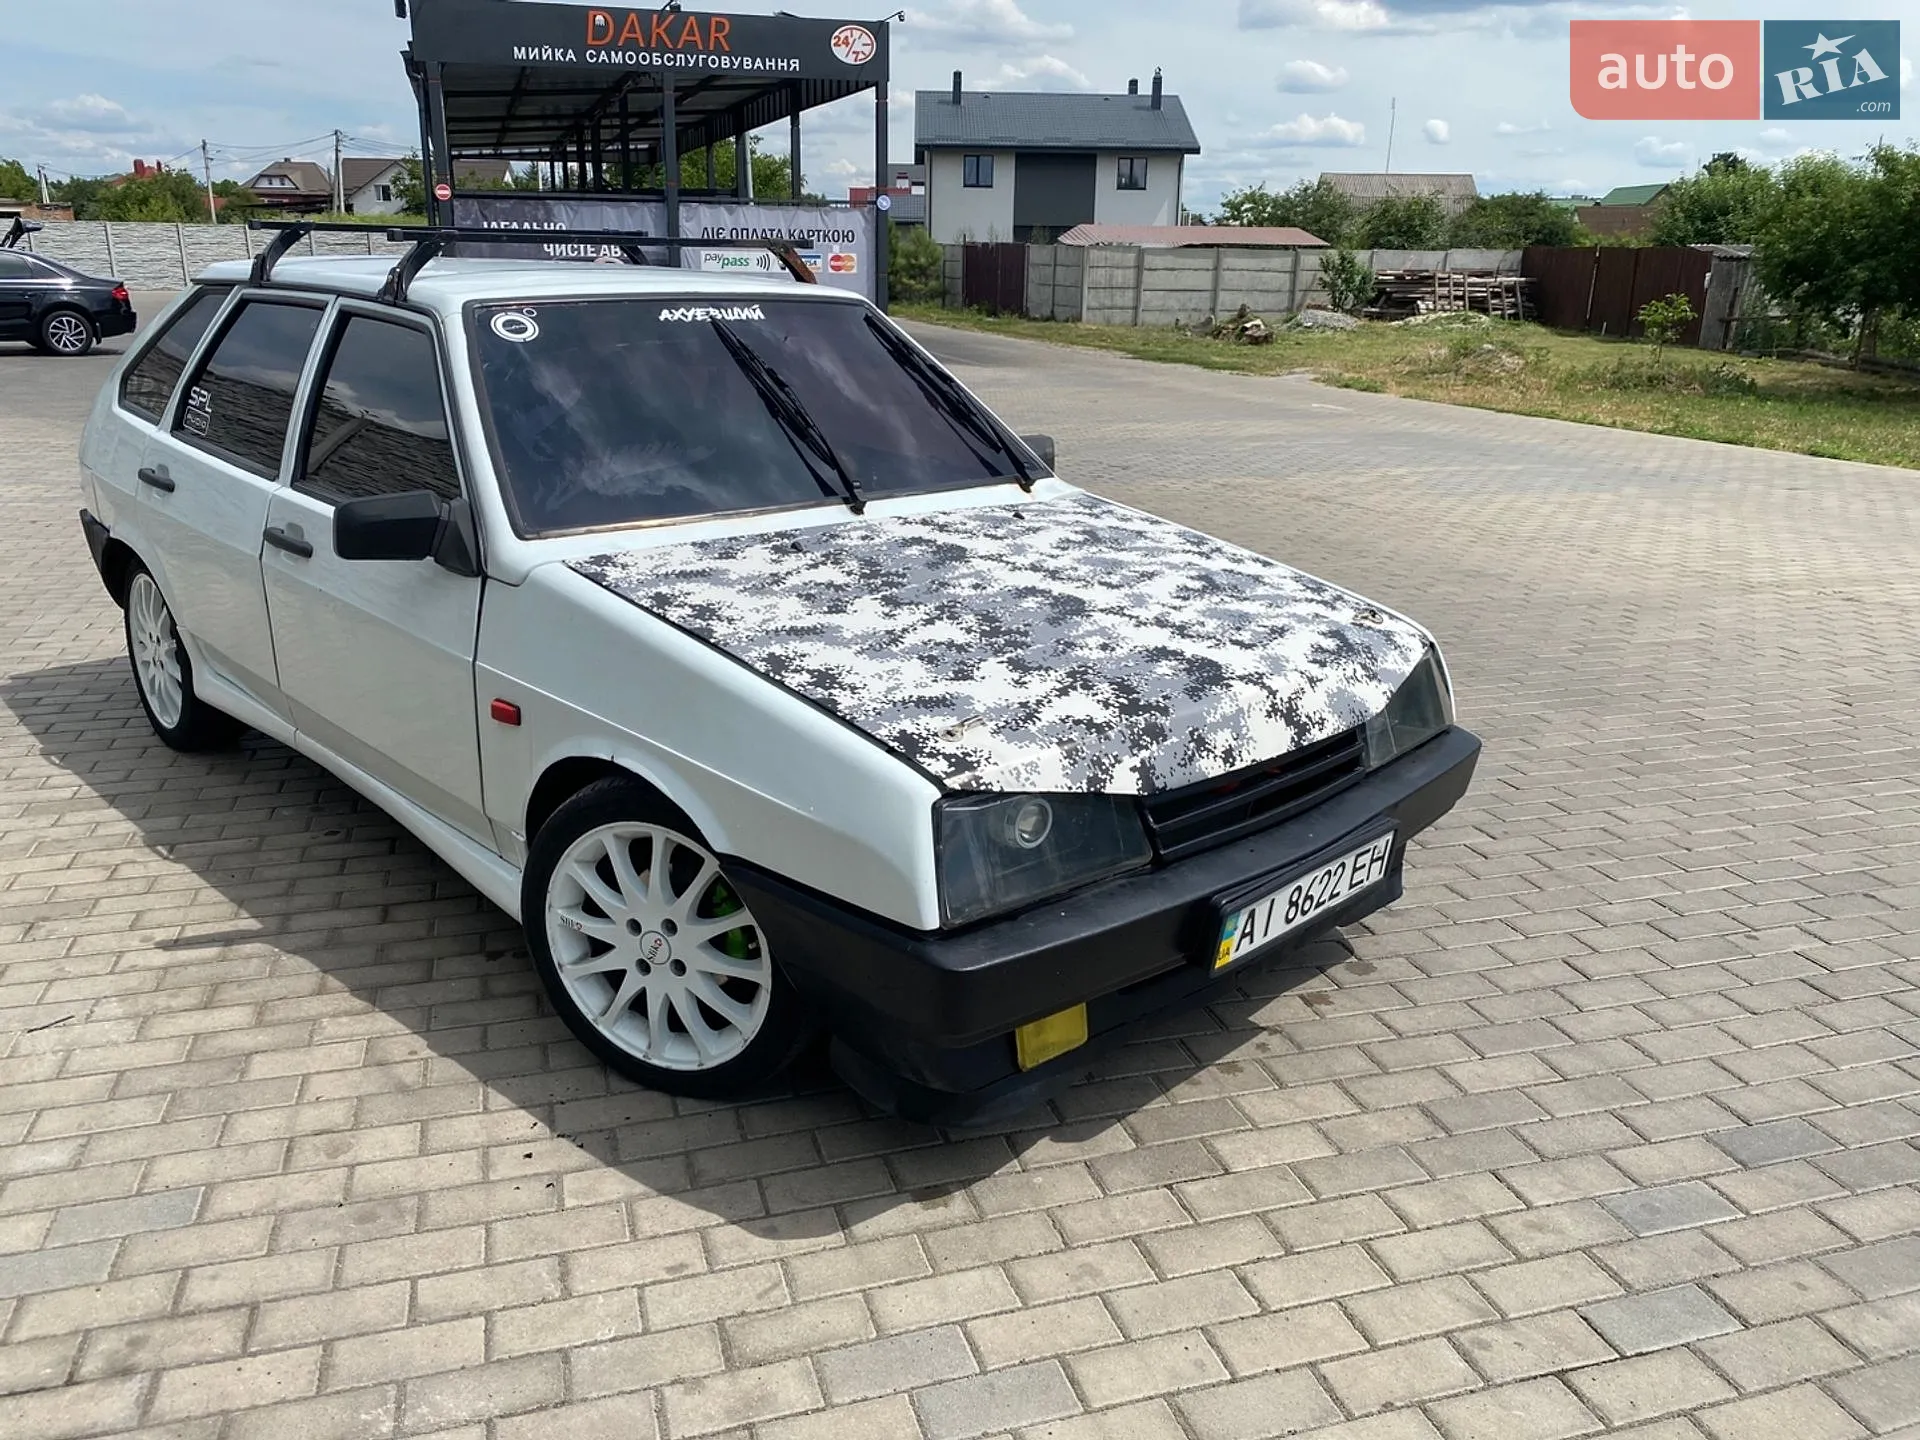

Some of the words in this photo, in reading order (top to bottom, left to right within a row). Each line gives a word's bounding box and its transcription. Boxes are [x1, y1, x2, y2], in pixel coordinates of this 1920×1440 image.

[585, 10, 732, 51] DAKAR
[513, 46, 577, 62] МИЙКА
[585, 50, 800, 72] САМООБСЛУГОВУВАННЯ
[730, 227, 784, 241] ОПЛАТА
[788, 229, 855, 243] КАРТКОЮ
[543, 243, 597, 257] ЧИСТЕ
[1284, 861, 1346, 926] 8622
